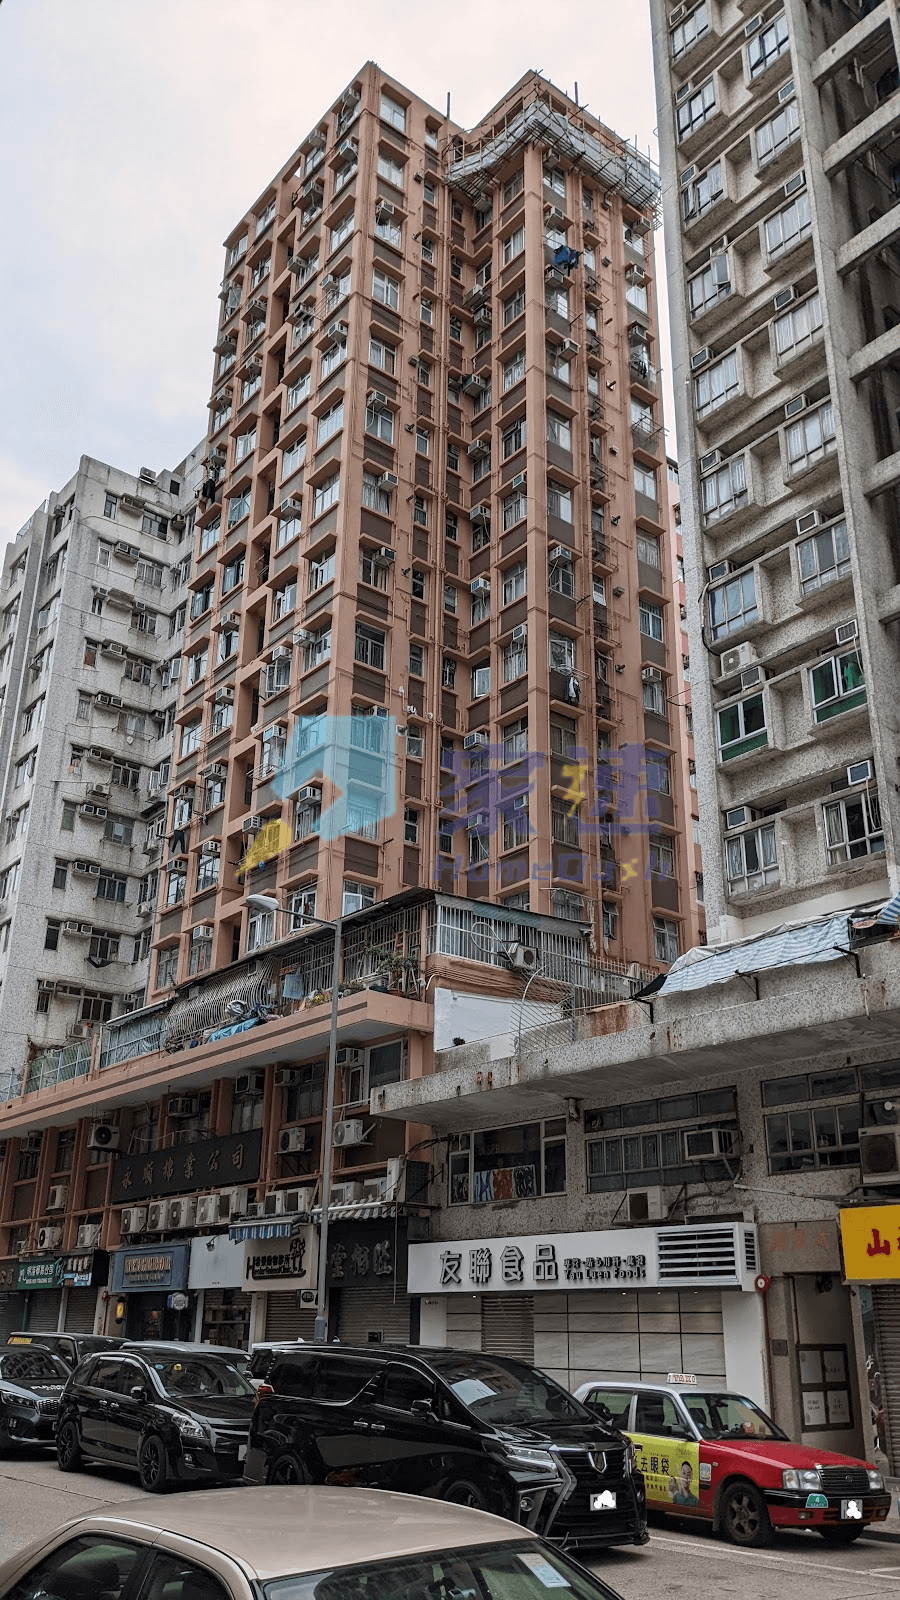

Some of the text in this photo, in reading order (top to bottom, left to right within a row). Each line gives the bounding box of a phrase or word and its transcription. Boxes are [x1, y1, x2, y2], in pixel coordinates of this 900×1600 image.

[866, 1227, 900, 1257] 山
[439, 1243, 559, 1285] 友聯食品
[563, 1267, 646, 1280] Yau Luen Foods
[672, 1374, 692, 1383] TAXI
[637, 1456, 670, 1476] 去眼袋
